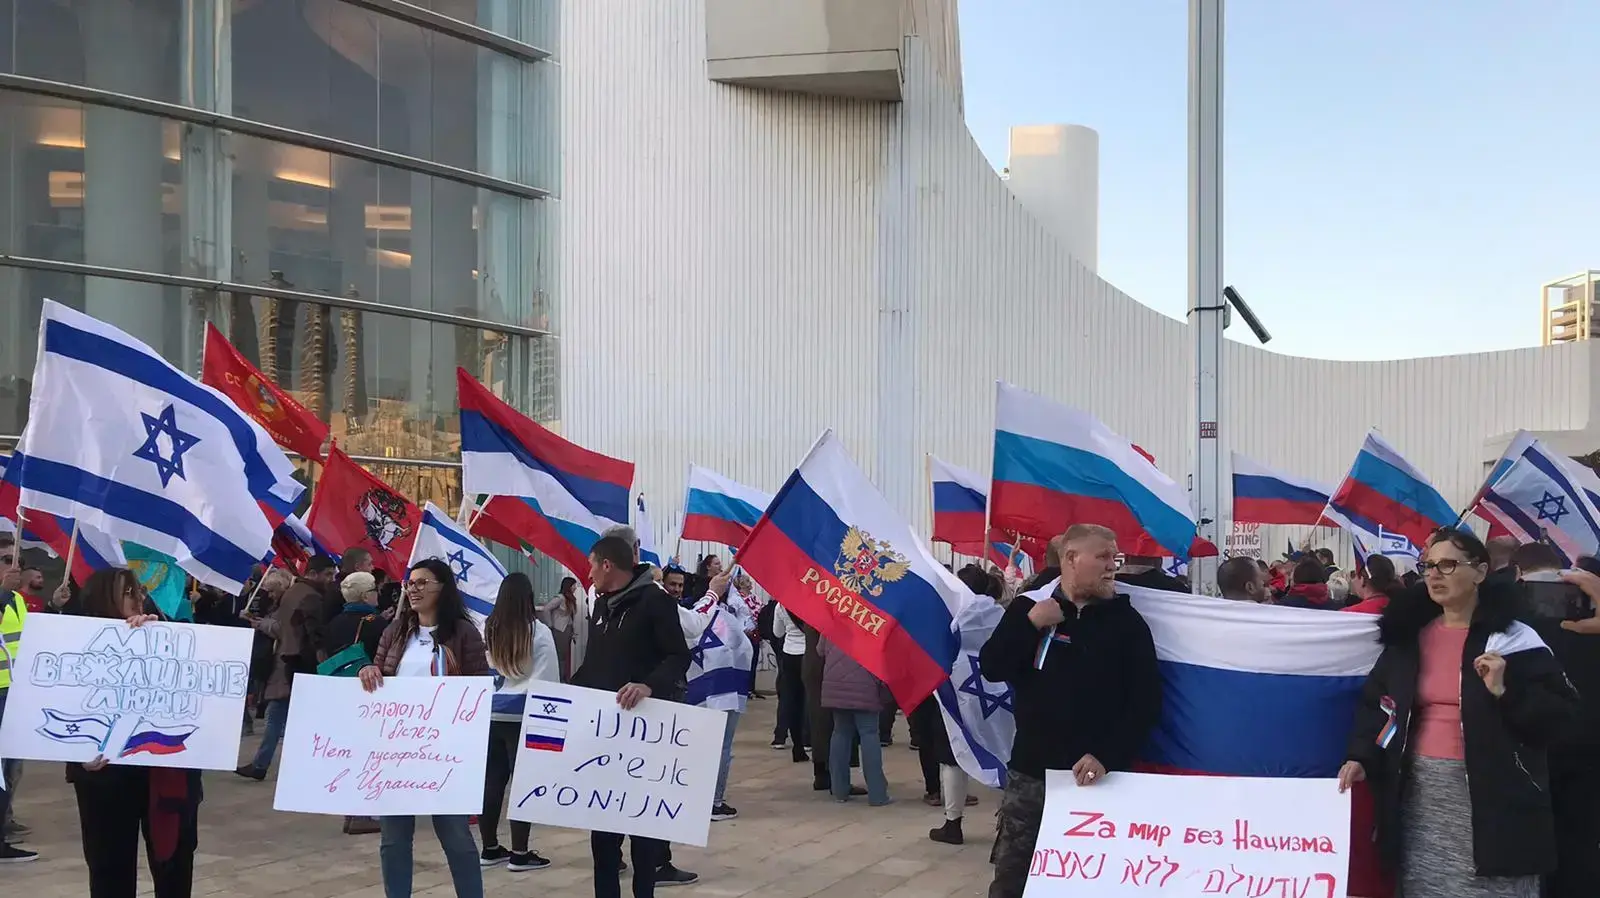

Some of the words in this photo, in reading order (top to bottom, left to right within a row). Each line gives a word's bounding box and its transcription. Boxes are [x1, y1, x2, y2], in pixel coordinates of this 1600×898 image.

[800, 567, 887, 637] РОССИЯ
[85, 623, 197, 657] МЫ
[30, 651, 249, 699] ВЕЖЛИВЫЕ
[81, 687, 203, 719] ЛЮДИ
[452, 686, 487, 725] לא
[312, 733, 353, 760] Нет
[363, 744, 464, 771] русофобии
[573, 752, 689, 787] אנשים
[324, 768, 350, 793] в
[356, 767, 453, 800] Израиле!
[1127, 821, 1171, 848] мир
[1232, 818, 1337, 854] Нацизма
[1121, 854, 1180, 887] ללא
